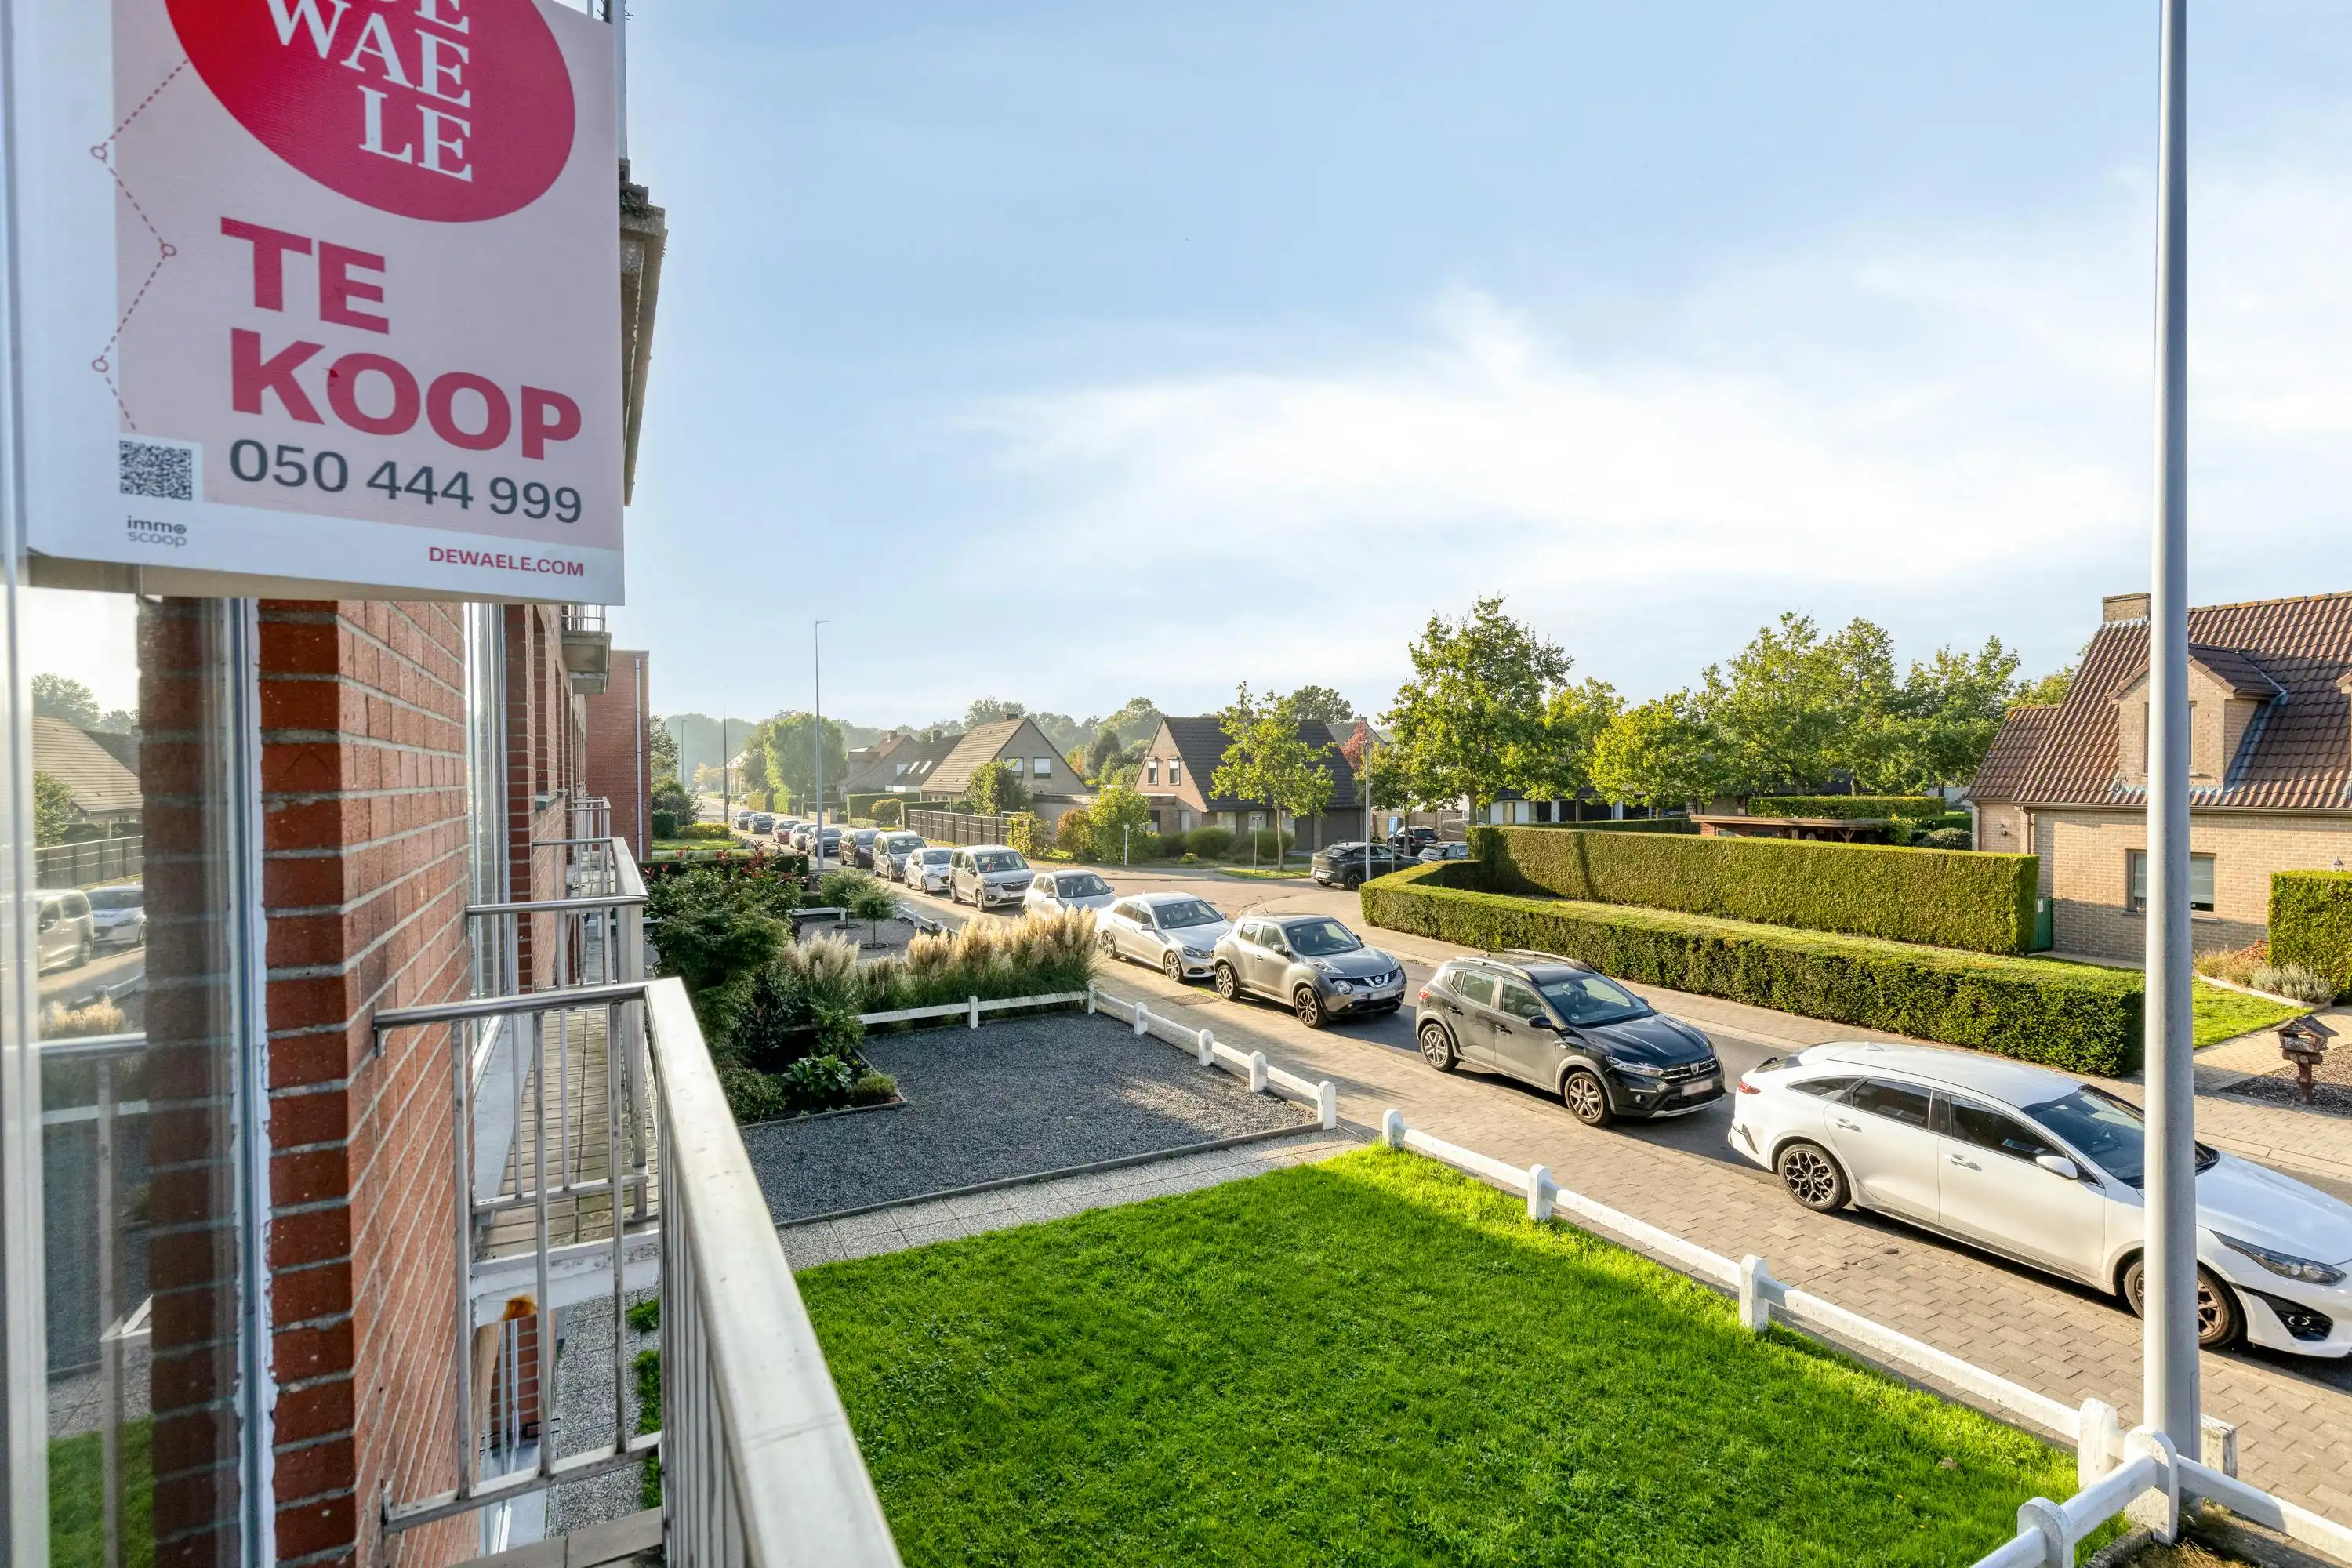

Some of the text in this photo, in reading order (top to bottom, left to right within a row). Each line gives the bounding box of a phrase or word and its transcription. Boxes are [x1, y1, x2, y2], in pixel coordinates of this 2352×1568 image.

[267, 0, 470, 108] WAE
[358, 85, 473, 183] LE
[220, 216, 390, 335] TE
[230, 328, 582, 460] KOOP
[230, 439, 582, 524] 050 444 999
[128, 531, 187, 549] scoop
[429, 546, 585, 577] DEWAELE.COM
